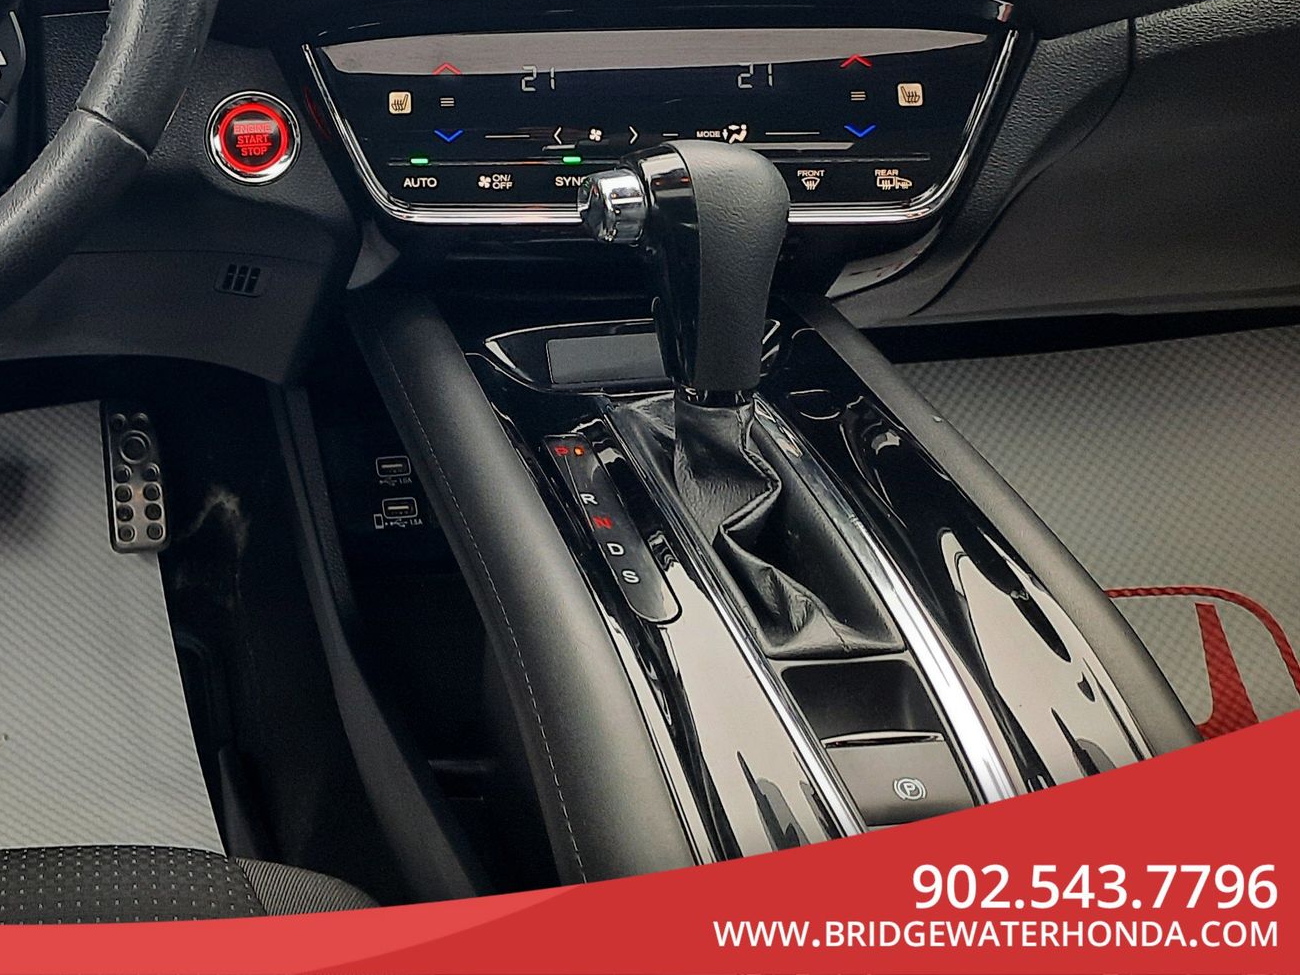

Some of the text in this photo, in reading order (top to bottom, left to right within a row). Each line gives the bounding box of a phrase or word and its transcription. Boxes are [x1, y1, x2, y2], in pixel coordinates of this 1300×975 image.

[521, 65, 556, 92] 21
[737, 63, 773, 89] 21
[233, 122, 272, 134] ENGINE
[237, 134, 269, 145] START
[696, 130, 721, 138] MODE
[241, 146, 268, 157] STOP
[492, 174, 511, 183] ON/
[797, 170, 825, 178] FRONT
[874, 169, 899, 177] REAR
[403, 177, 438, 188] AUTO
[492, 181, 513, 190] OFF
[579, 493, 598, 505] R
[606, 542, 625, 556] D
[621, 569, 640, 584] S
